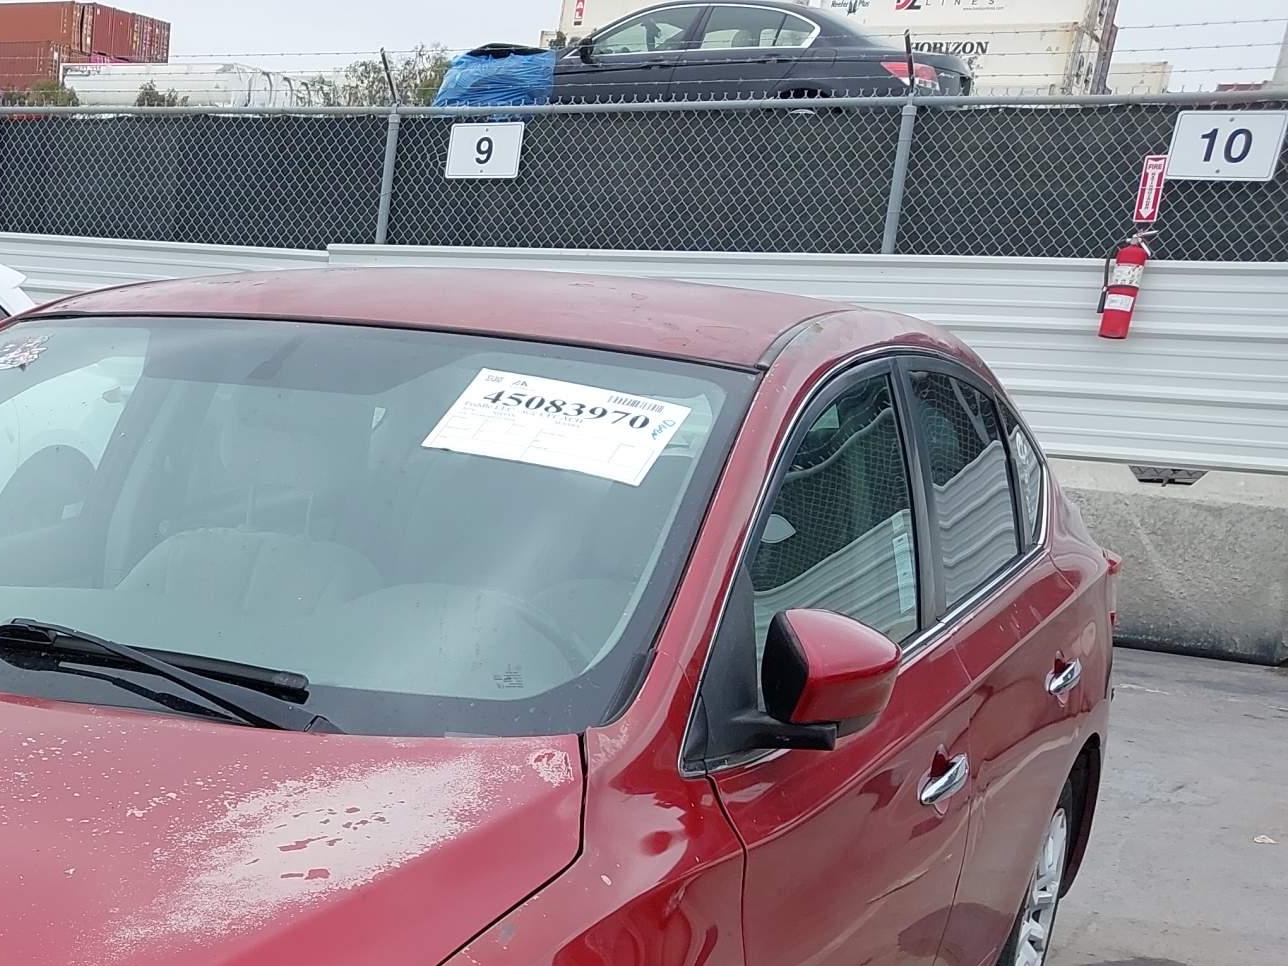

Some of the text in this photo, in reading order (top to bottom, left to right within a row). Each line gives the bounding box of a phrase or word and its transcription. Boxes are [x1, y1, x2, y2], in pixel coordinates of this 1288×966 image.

[911, 41, 989, 54] HORIZON
[475, 136, 494, 165] 9
[1200, 127, 1253, 164] 10
[483, 390, 650, 429] 45083970
